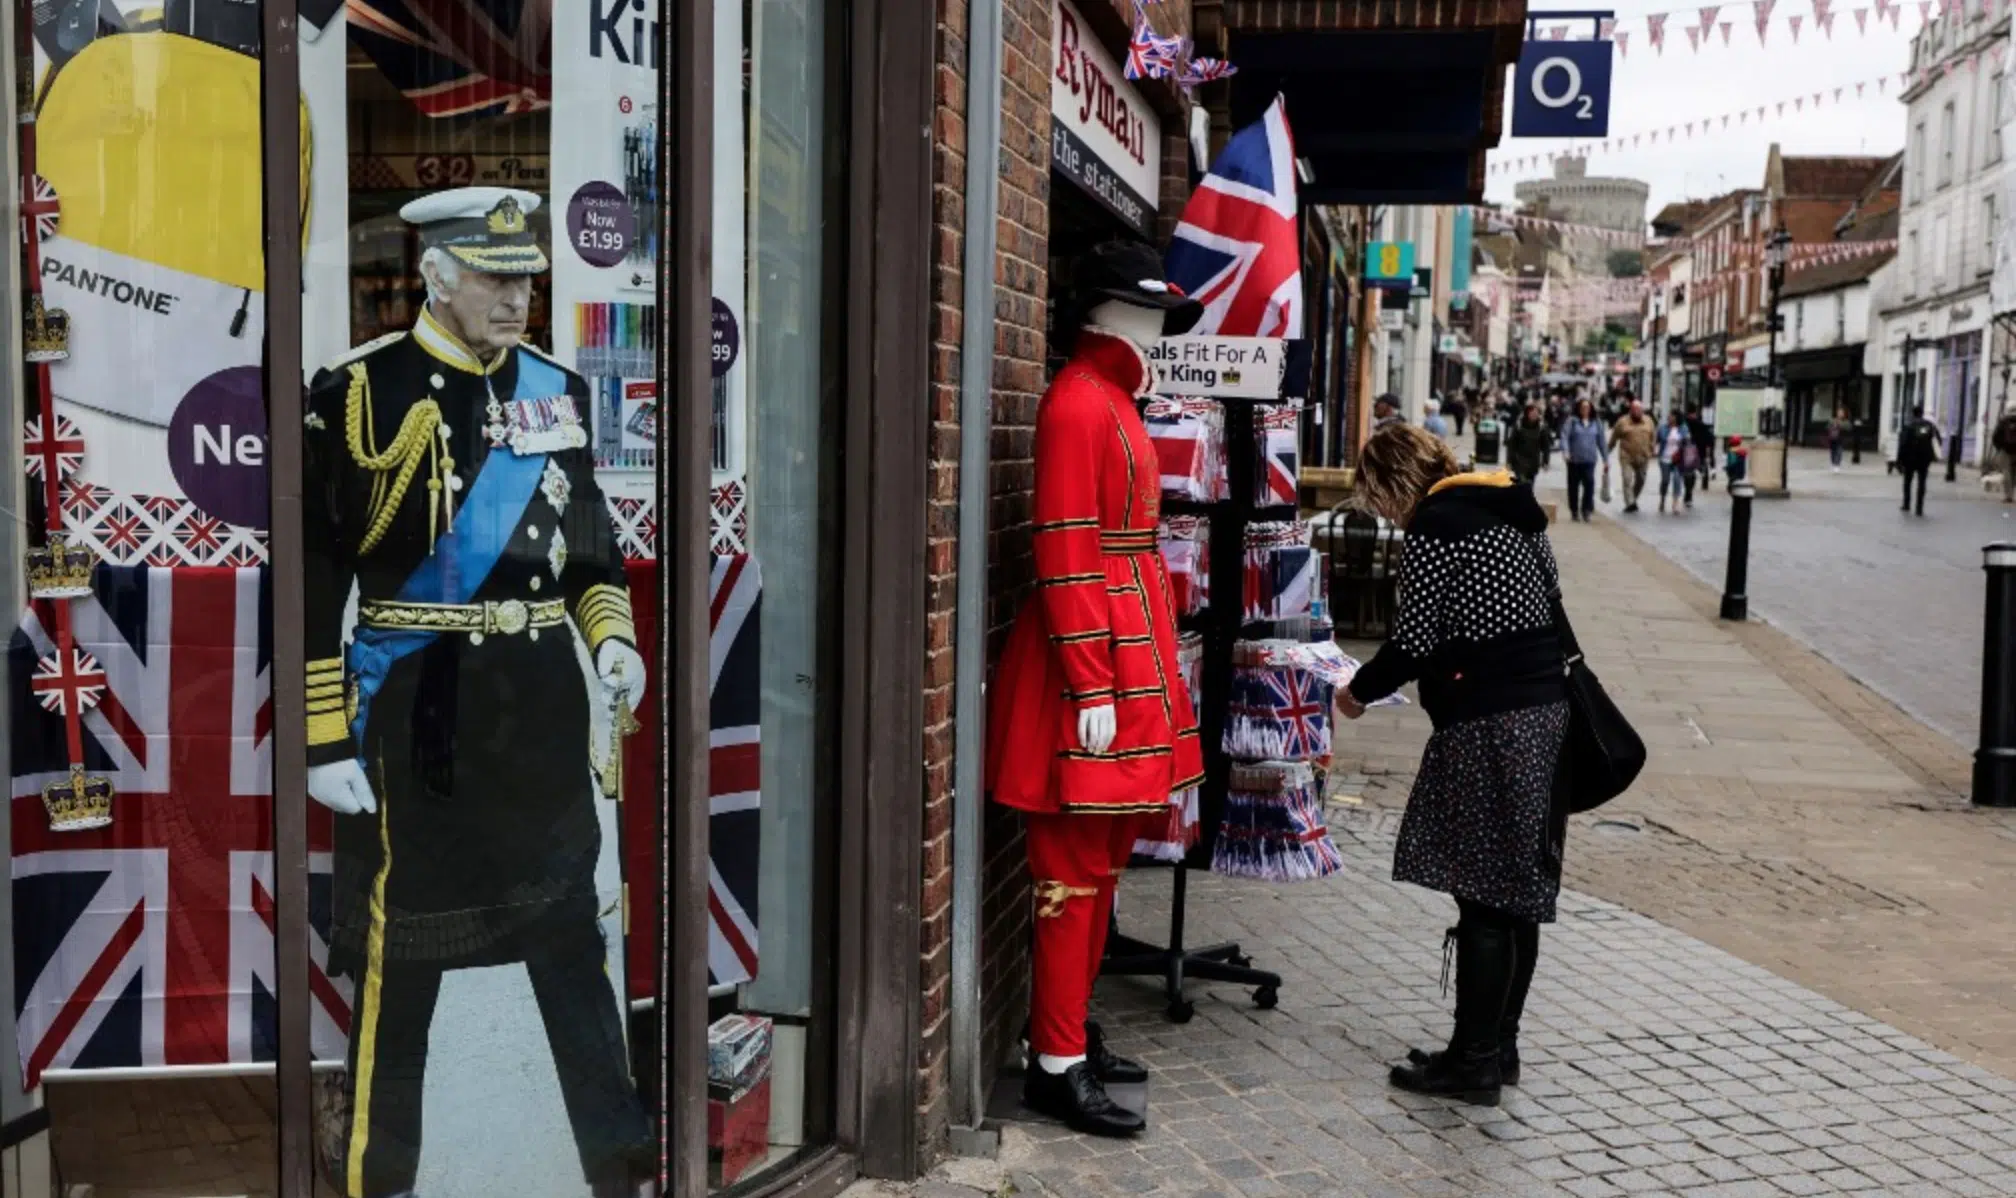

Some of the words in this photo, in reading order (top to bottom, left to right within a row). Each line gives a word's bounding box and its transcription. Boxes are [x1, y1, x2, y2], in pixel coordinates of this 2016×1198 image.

[1055, 1, 1145, 166] Ryman
[1052, 124, 1081, 175] the
[1083, 161, 1143, 227] stationer
[586, 211, 617, 228] Now
[578, 228, 624, 250] £1.99
[1183, 342, 1210, 362] Fit
[1215, 344, 1247, 364] For
[1252, 346, 1268, 364] A
[1171, 363, 1217, 387] King
[192, 423, 268, 467] Ne
